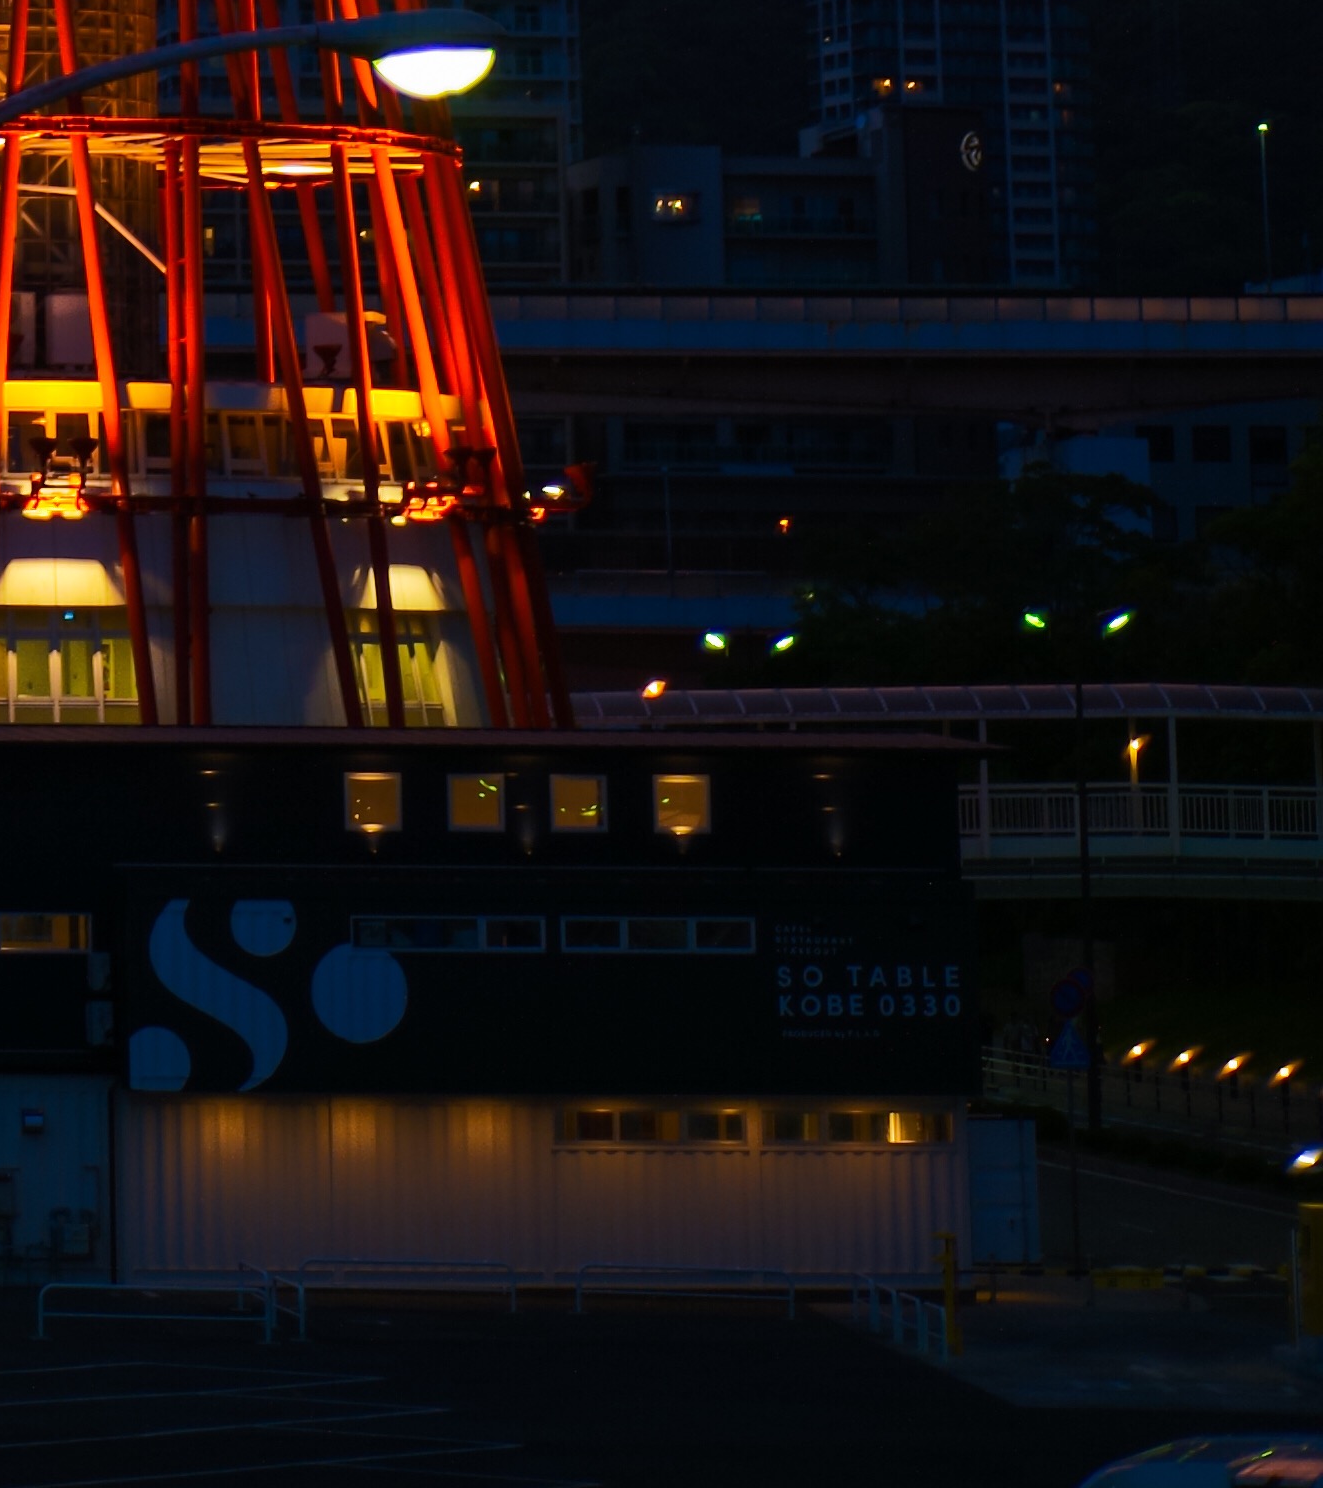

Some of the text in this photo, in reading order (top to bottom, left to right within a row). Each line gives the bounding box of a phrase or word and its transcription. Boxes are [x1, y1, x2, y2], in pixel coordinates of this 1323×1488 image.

[777, 964, 961, 988] SO TABLE
[778, 993, 962, 1017] KOBE 0330
